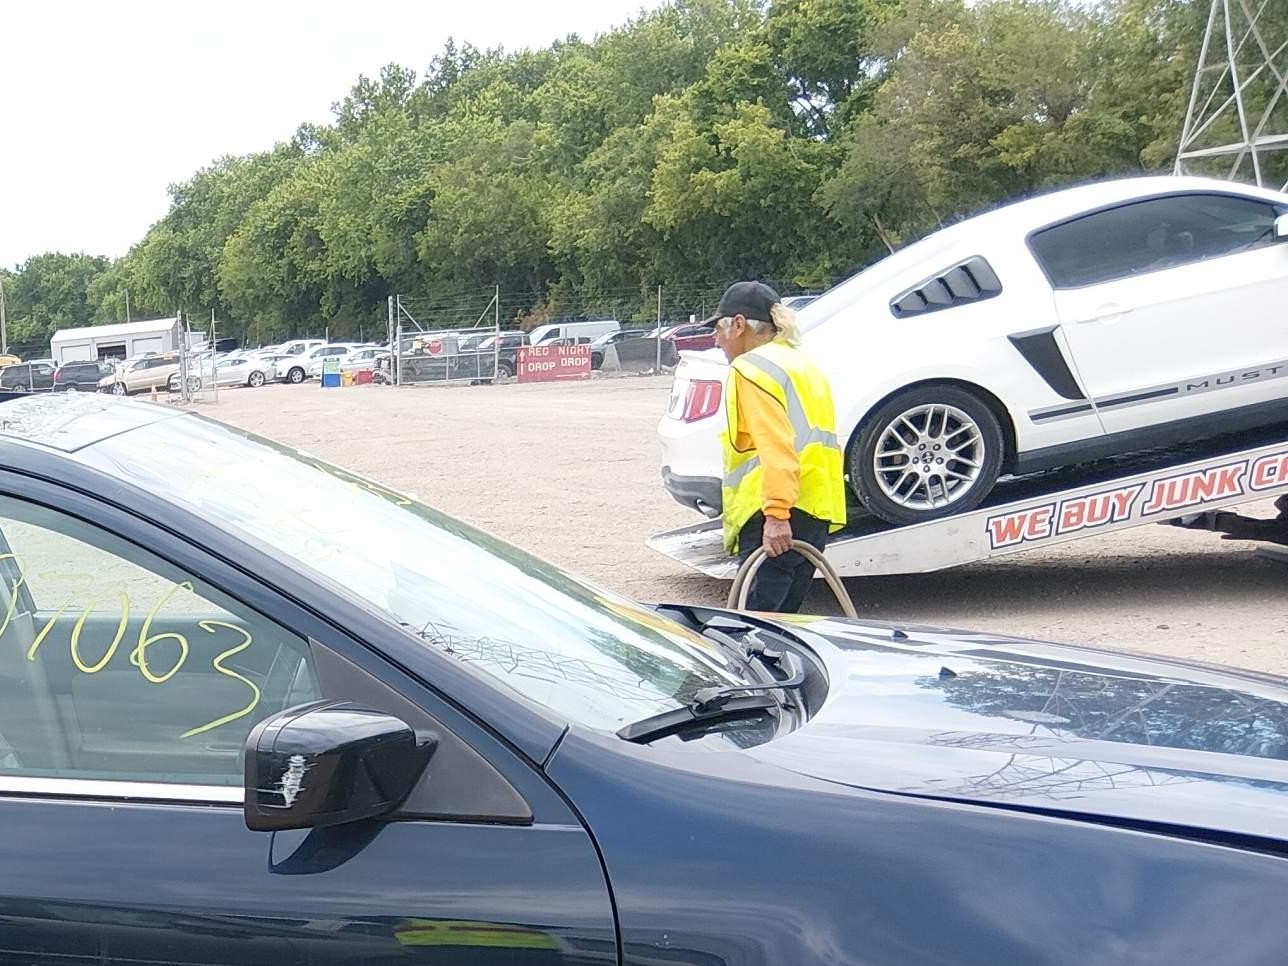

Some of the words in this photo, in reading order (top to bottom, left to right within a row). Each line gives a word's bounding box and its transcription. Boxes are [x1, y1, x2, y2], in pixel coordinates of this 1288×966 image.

[557, 345, 590, 357] NIGHT
[527, 361, 556, 372] DROP
[560, 357, 589, 367] DROP
[988, 505, 1054, 547] WE
[1058, 485, 1141, 532] BUY
[1143, 462, 1247, 514] JUNK
